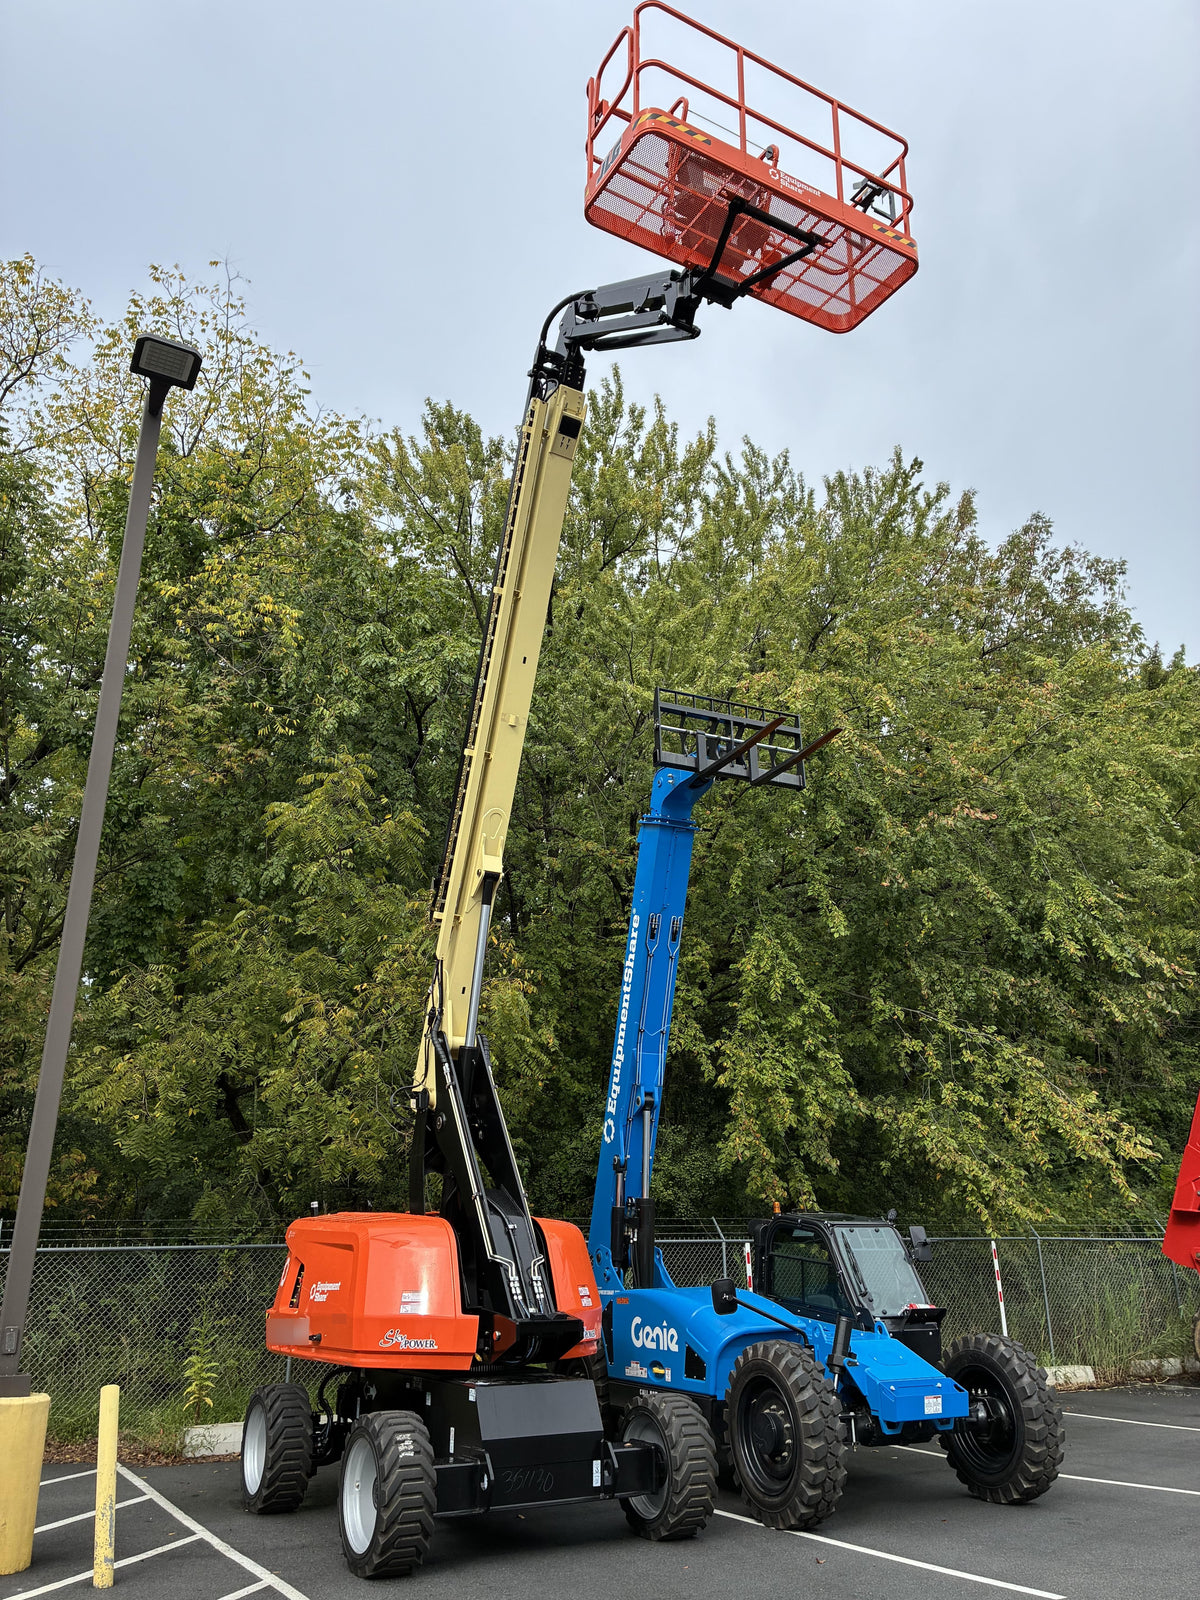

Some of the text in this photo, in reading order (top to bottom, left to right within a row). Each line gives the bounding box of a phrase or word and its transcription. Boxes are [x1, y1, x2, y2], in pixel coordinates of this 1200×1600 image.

[780, 171, 822, 197] Equipment
[780, 179, 803, 195] Share
[607, 914, 640, 1115] EquipmentShare
[379, 1329, 436, 1349] Sky POWER
[631, 1316, 679, 1352] Genie
